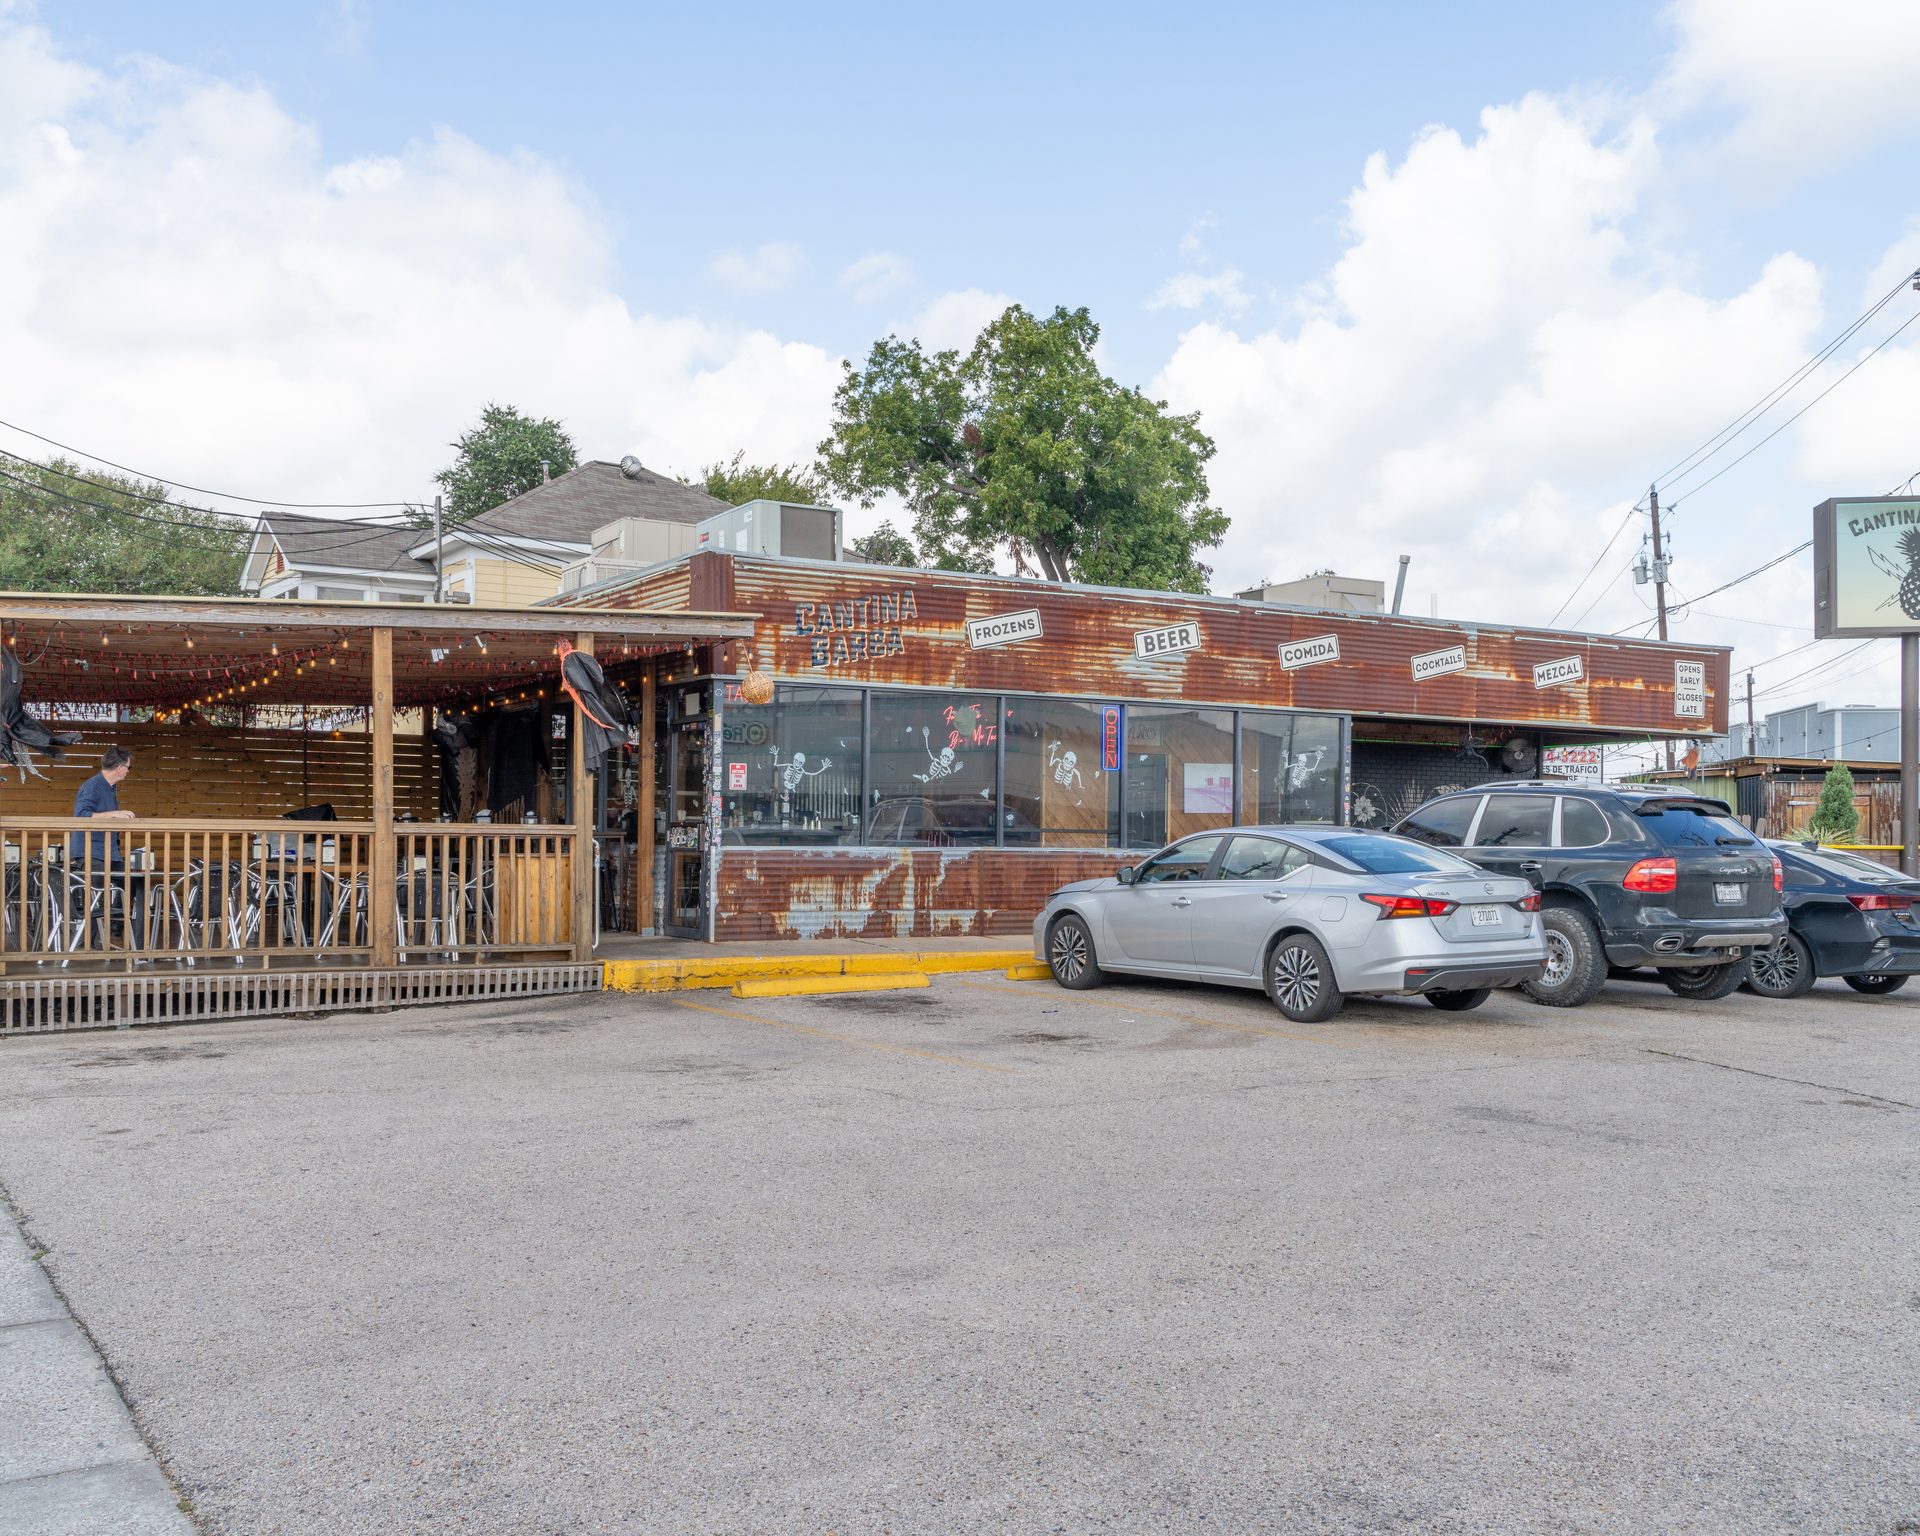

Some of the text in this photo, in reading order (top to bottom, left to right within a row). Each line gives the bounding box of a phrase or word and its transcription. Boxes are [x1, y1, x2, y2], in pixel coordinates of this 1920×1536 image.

[795, 589, 918, 636] CANTINA
[975, 618, 1036, 640] FROZENS
[811, 627, 905, 667] BARBA
[1143, 628, 1191, 653] BEER
[1284, 642, 1335, 662] COMIDA
[1415, 654, 1463, 673] COCKTAILS
[1537, 662, 1579, 683] MEZCAL
[1678, 665, 1701, 674] OPENS
[1680, 676, 1700, 685] EARLY
[1677, 693, 1703, 702] CLOSES
[1682, 705, 1697, 713] LATE
[1105, 709, 1118, 768] OPEN
[1552, 765, 1562, 773] DE
[1565, 765, 1598, 774] TRAFICO
